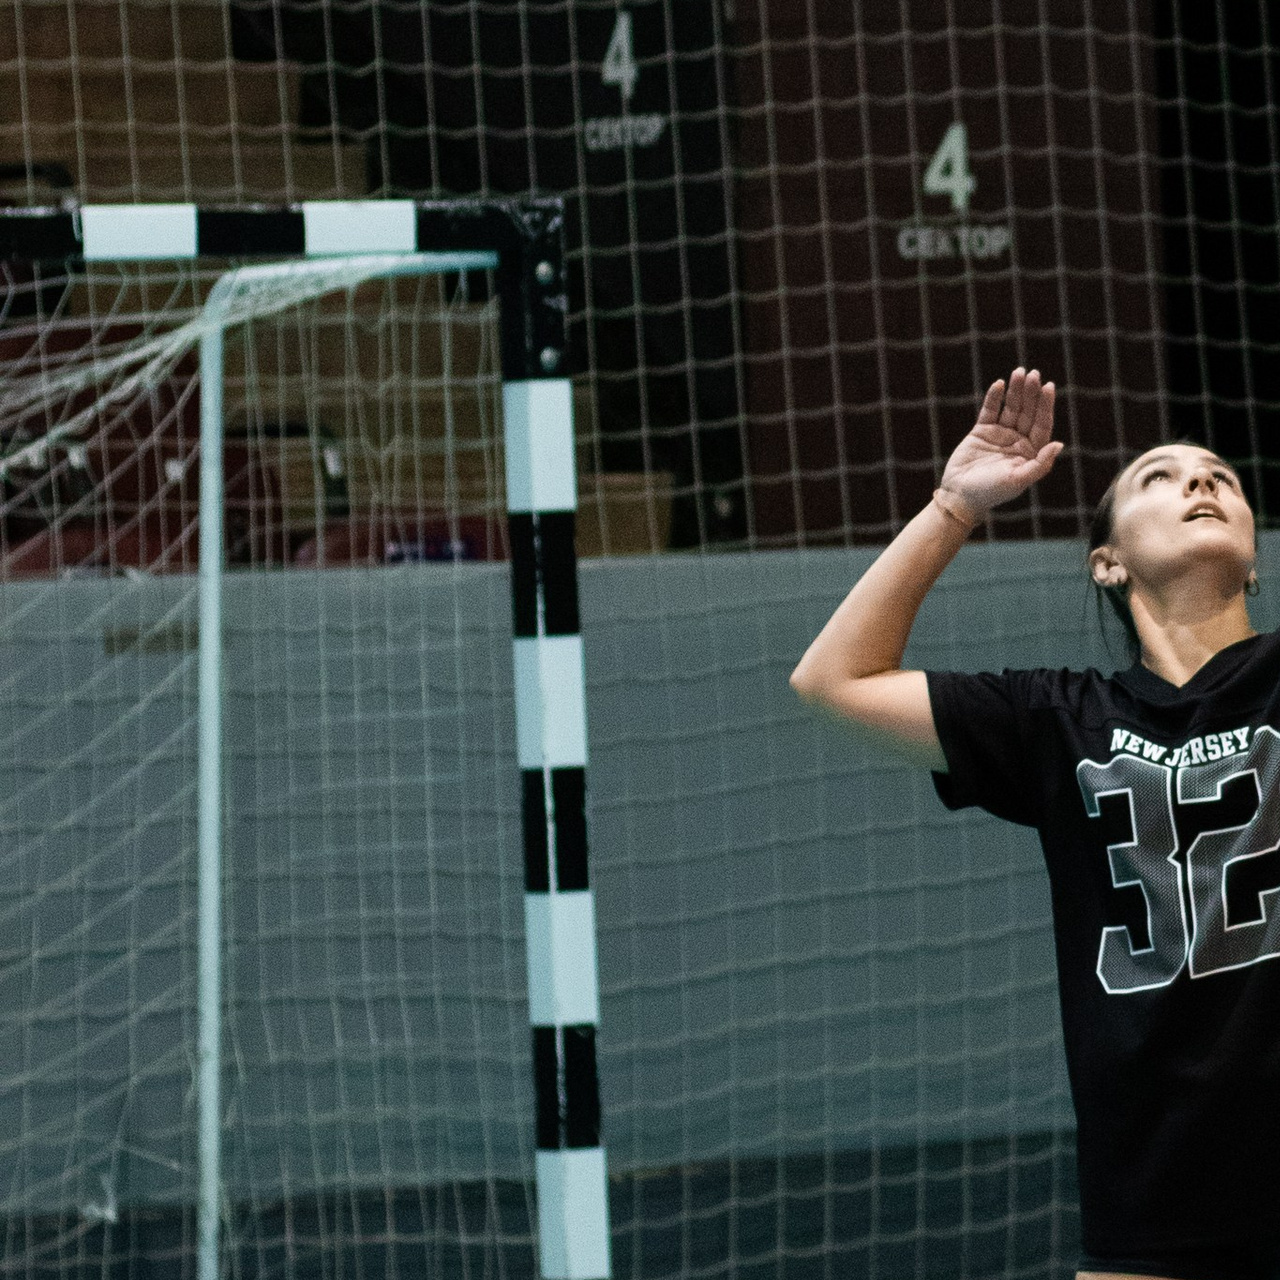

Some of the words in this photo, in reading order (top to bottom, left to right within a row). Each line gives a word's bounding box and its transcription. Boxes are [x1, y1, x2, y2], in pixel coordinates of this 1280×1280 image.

[602, 11, 637, 98] 4
[924, 123, 977, 210] 4
[1110, 728, 1167, 762] NEW
[1164, 726, 1250, 768] JERSEY
